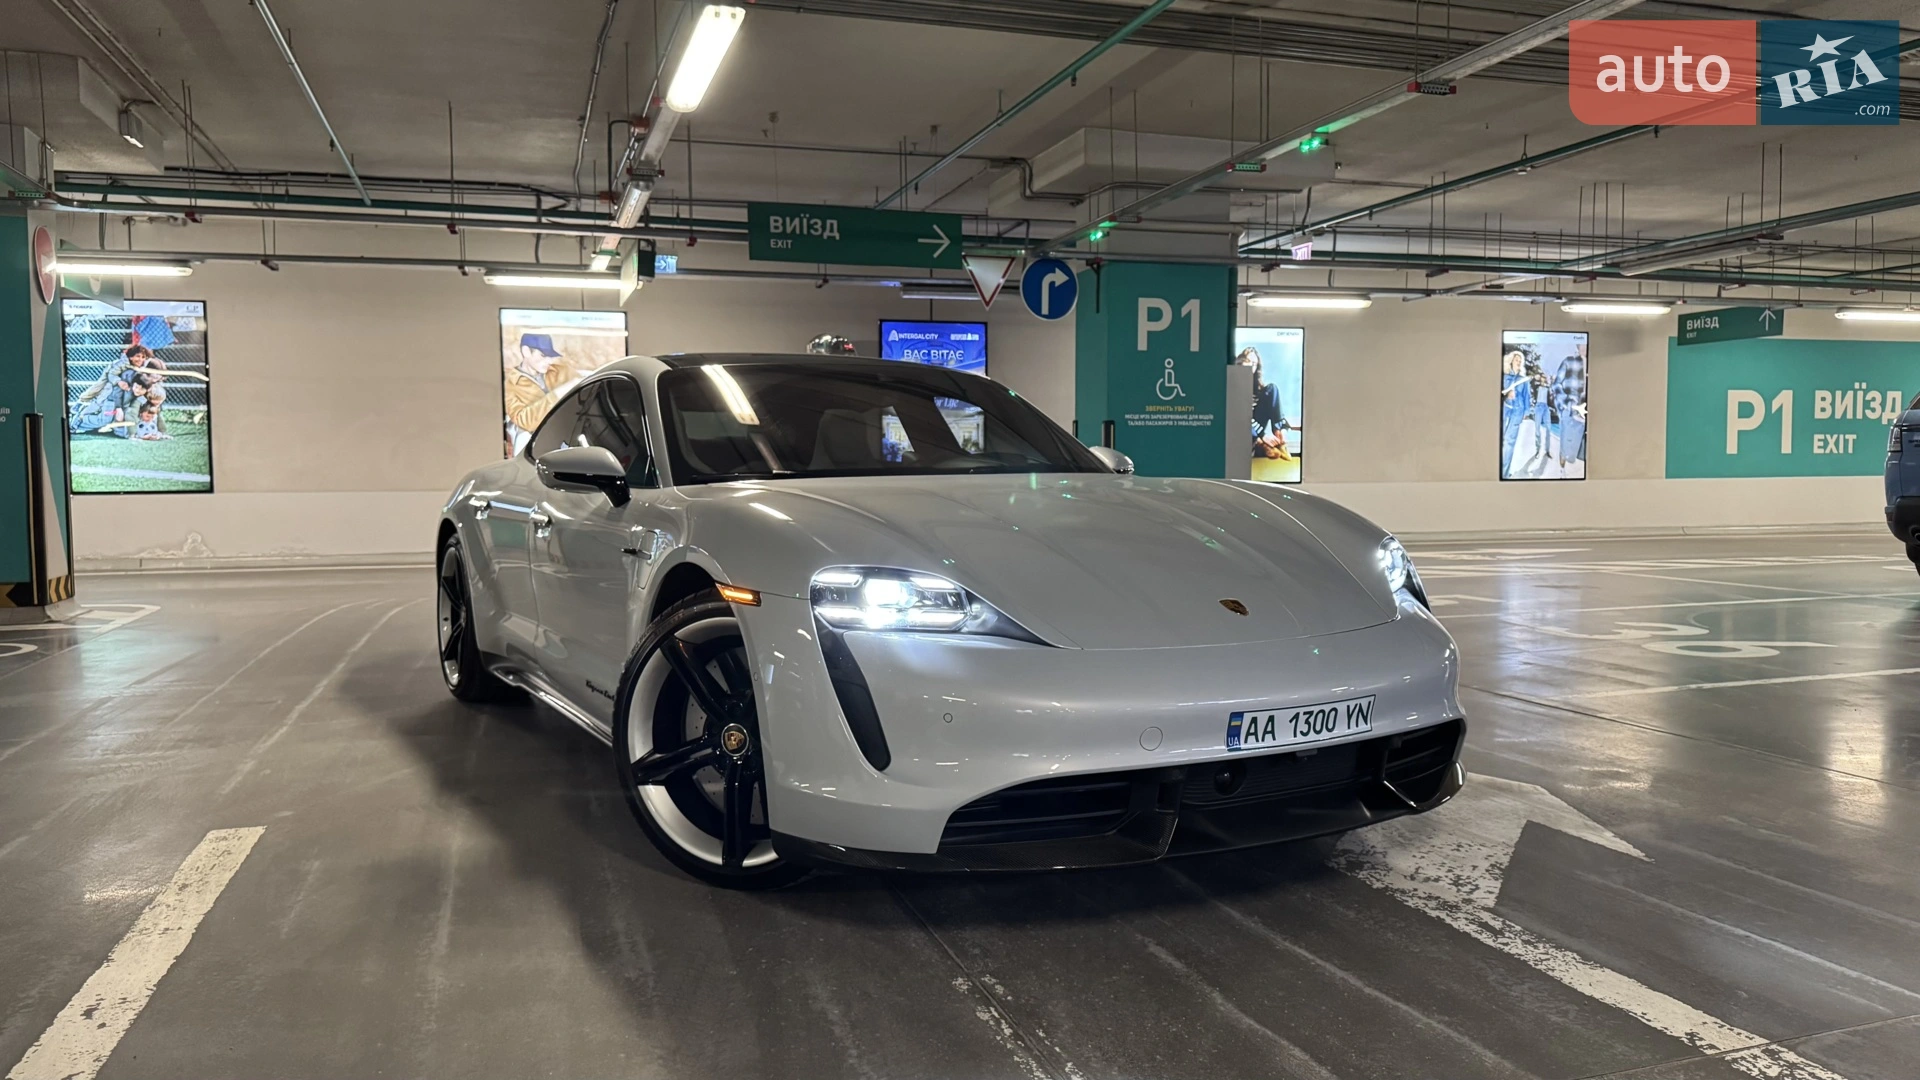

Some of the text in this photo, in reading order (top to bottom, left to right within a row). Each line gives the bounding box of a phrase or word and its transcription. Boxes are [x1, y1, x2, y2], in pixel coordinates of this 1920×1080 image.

[769, 213, 840, 240] ВИЇЗД
[770, 239, 793, 249] EXIT
[1137, 297, 1201, 352] P1
[1686, 315, 1720, 330] ВИЇЗД
[904, 350, 964, 360] ВАС ВІТАЄ
[1814, 382, 1902, 424] ВИЇЗД
[1726, 389, 1793, 454] P1
[1813, 434, 1857, 454] EXIT
[1244, 701, 1371, 743] AA 1300 YN
[1228, 736, 1240, 746] UA
